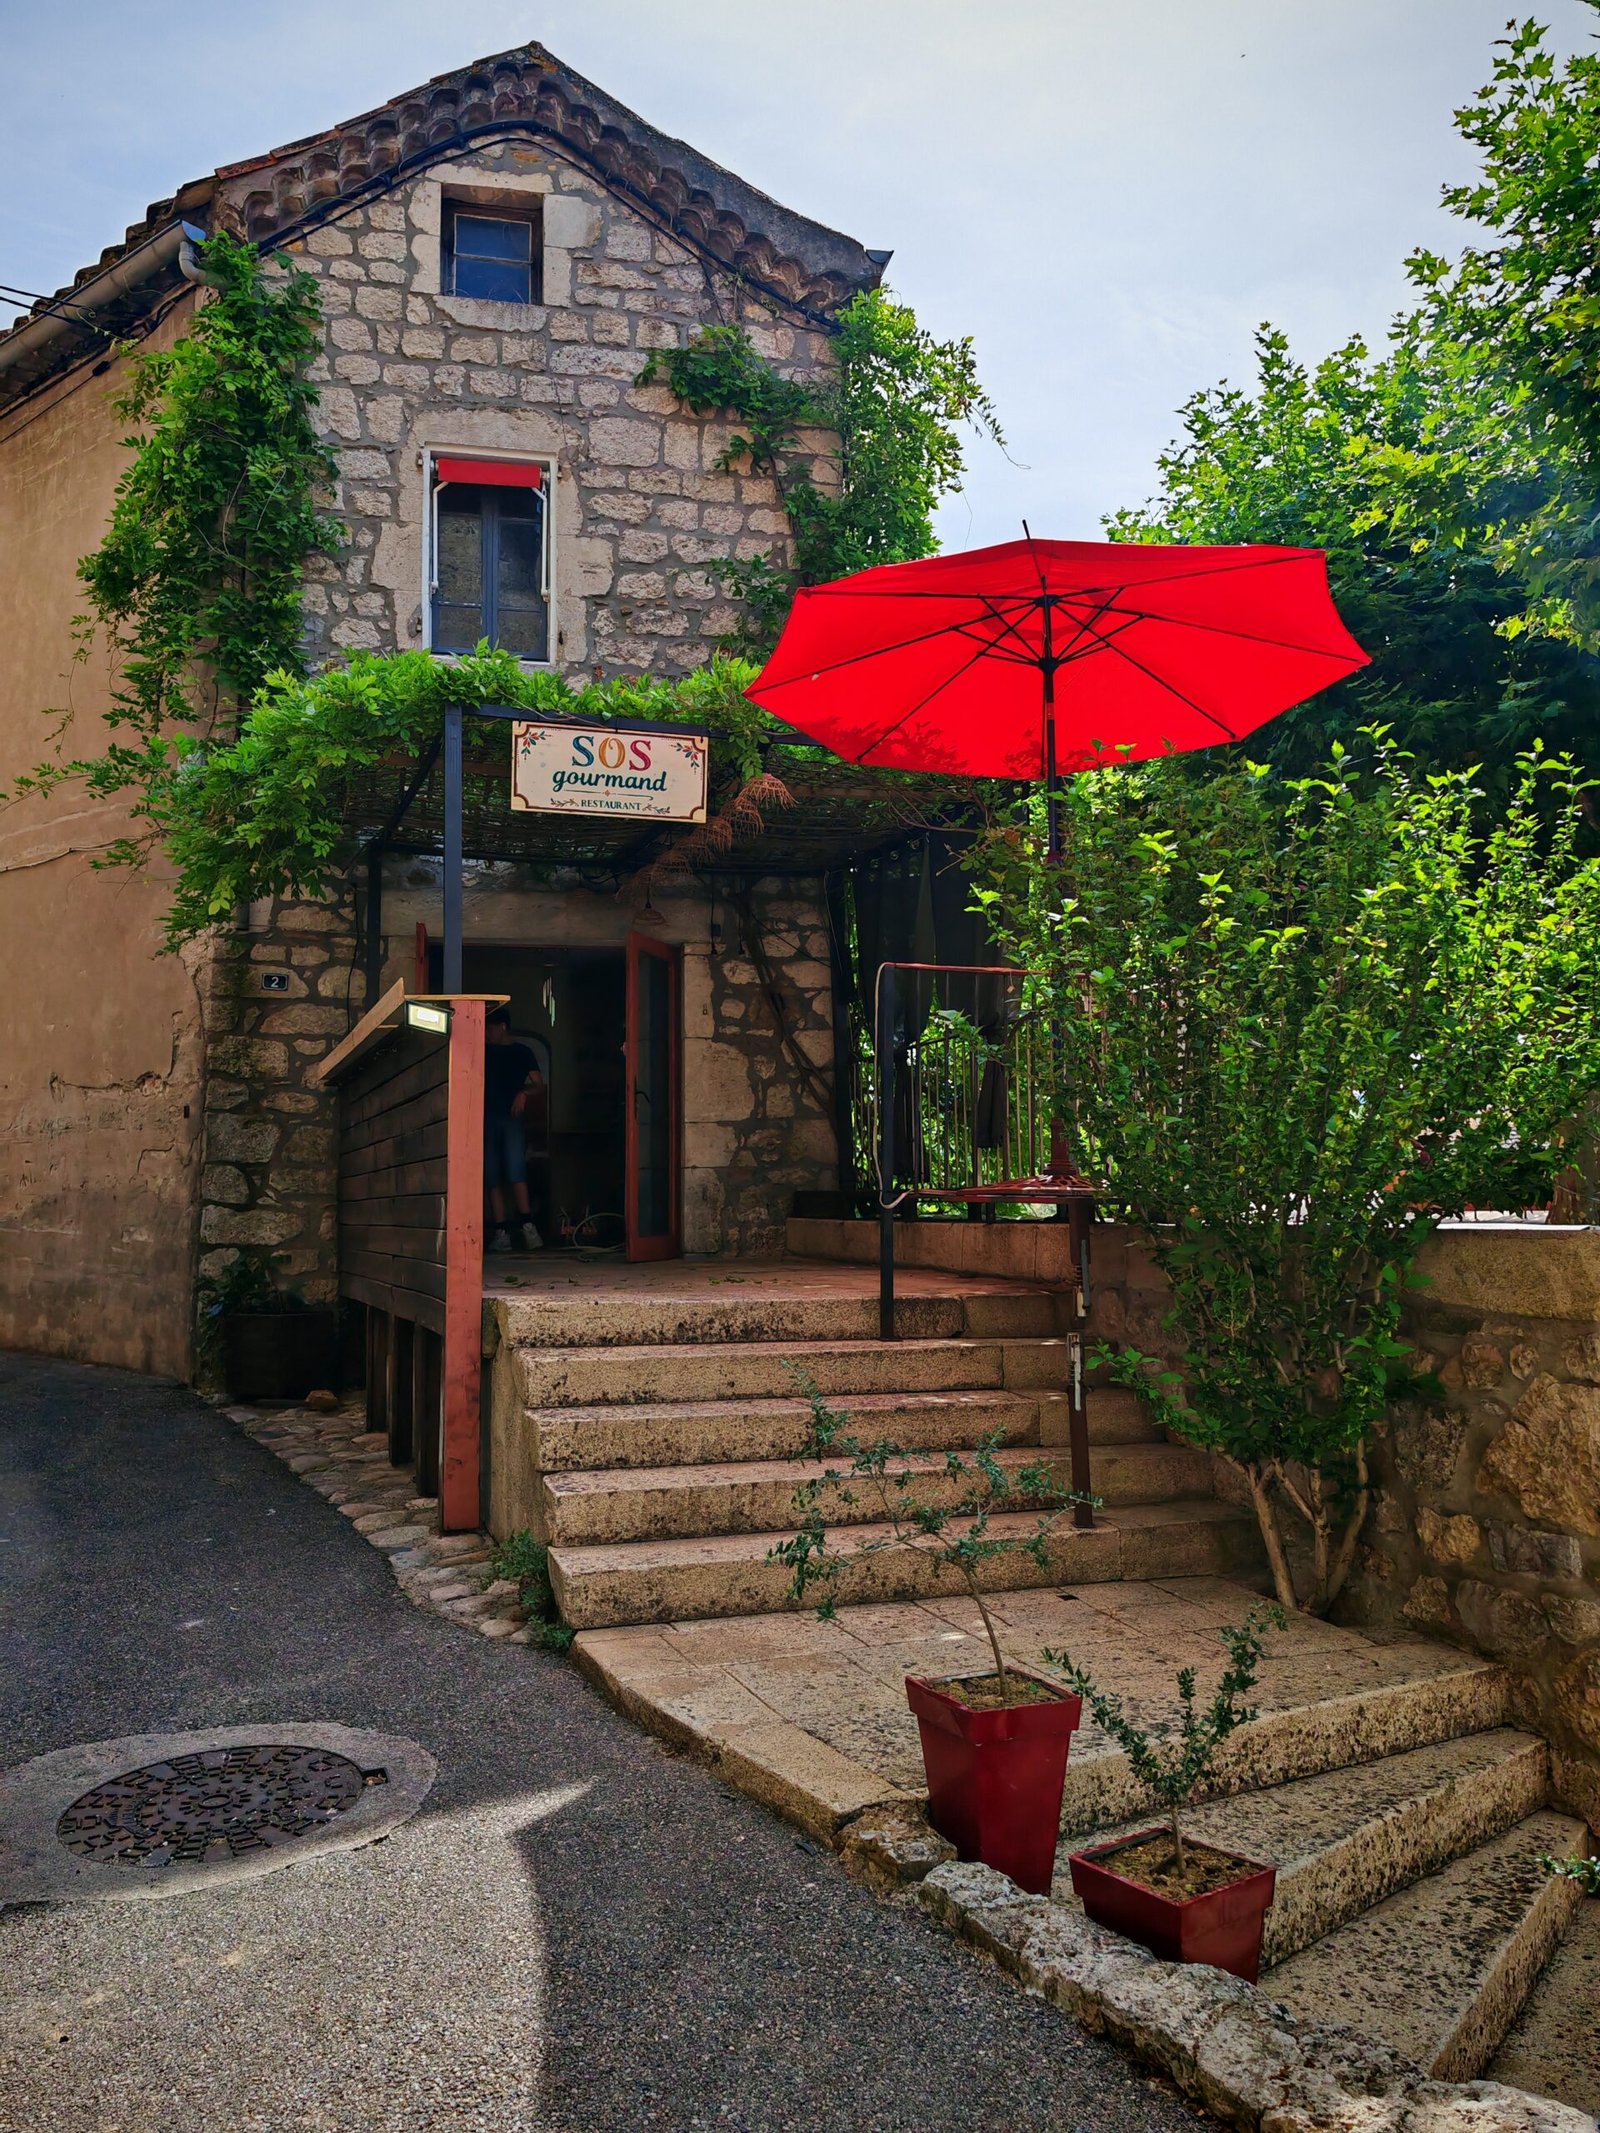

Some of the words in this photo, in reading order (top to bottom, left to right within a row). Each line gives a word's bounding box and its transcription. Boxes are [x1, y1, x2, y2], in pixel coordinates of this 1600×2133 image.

[572, 735, 652, 772] SOS
[552, 770, 667, 792] gourmand
[581, 799, 642, 811] RESTAURANT
[270, 976, 279, 988] 2
